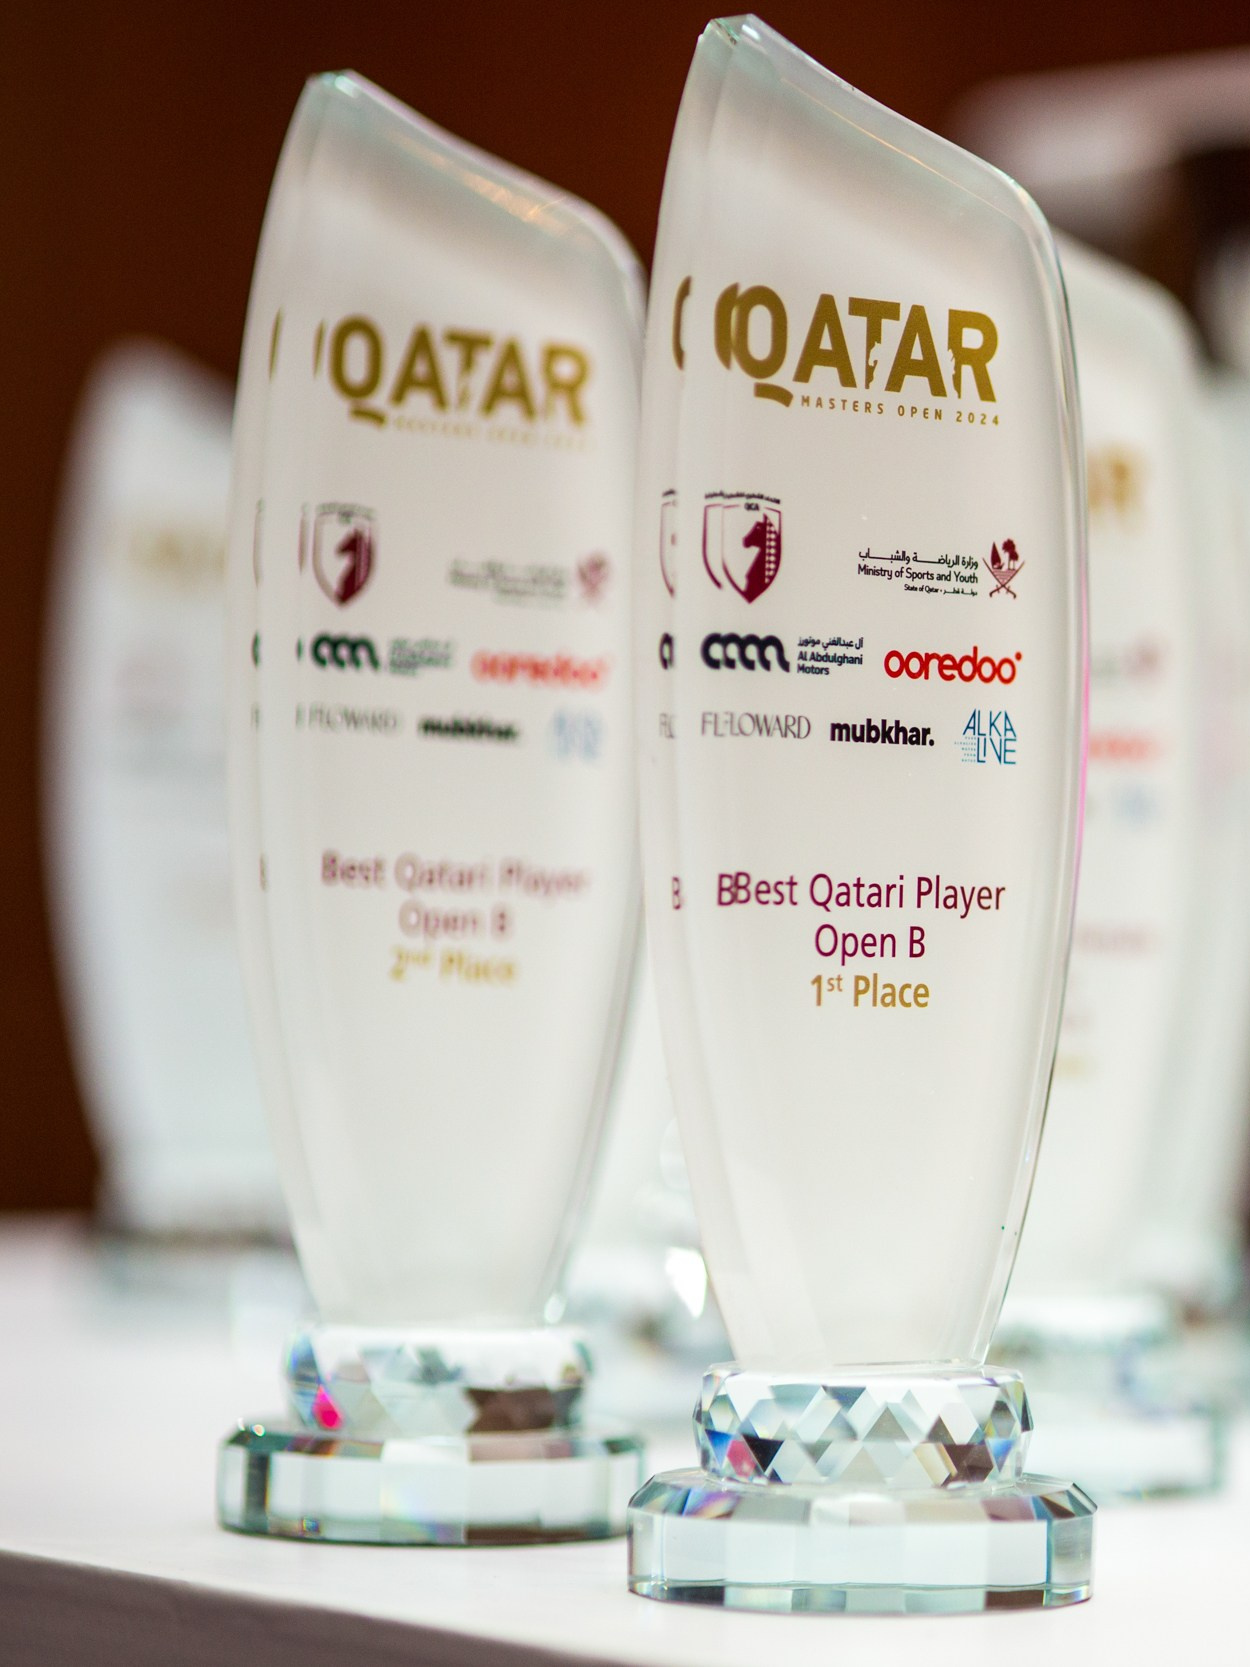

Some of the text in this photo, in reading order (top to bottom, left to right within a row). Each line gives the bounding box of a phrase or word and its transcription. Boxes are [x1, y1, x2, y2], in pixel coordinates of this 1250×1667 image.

[714, 282, 999, 408] QATAR
[328, 314, 592, 429] QATAR
[800, 395, 1000, 426] MASTERS OPEN 2024
[857, 563, 979, 584] Ministry of Sports and Youth
[961, 556, 979, 570] وزارة
[904, 583, 939, 594] State of Qatar
[797, 651, 863, 666] Al Abdulghani
[797, 663, 830, 675] Motors
[884, 645, 1020, 685] ooredoo
[962, 708, 1016, 737] ALKA
[809, 873, 904, 912] Qatari
[915, 874, 1005, 919] Player
[814, 923, 926, 966] Open B
[810, 972, 930, 1008] 1st Place
